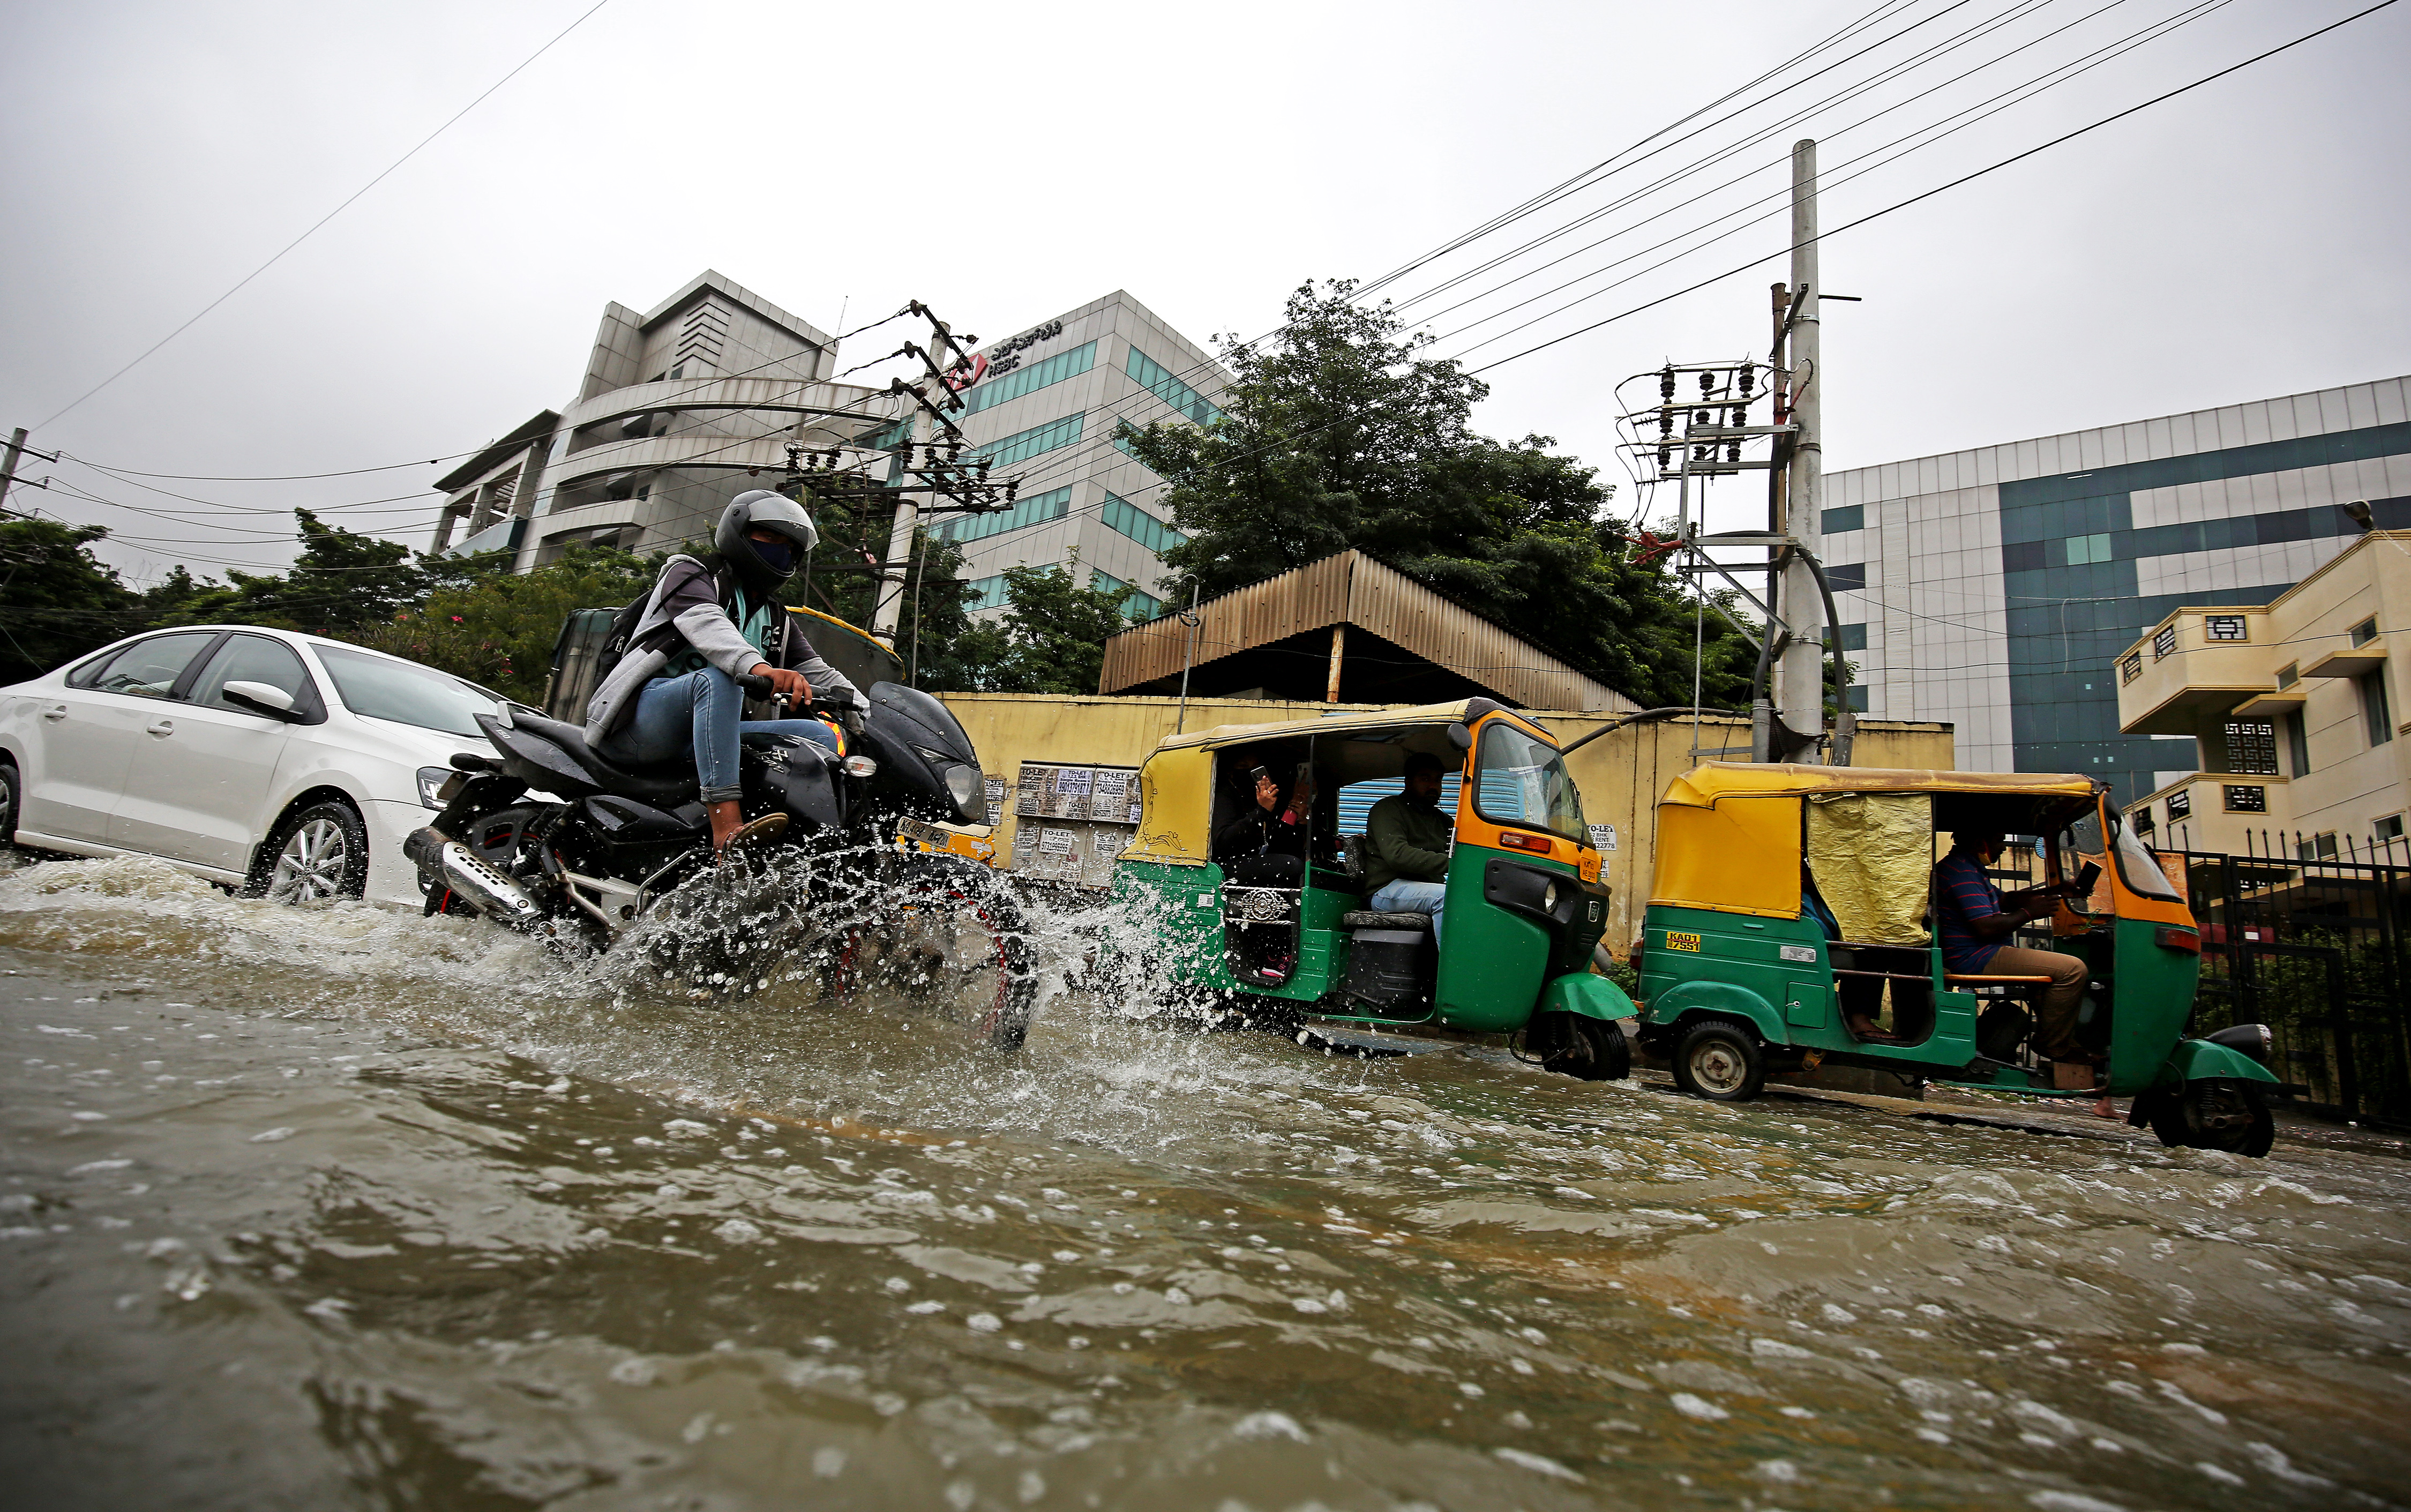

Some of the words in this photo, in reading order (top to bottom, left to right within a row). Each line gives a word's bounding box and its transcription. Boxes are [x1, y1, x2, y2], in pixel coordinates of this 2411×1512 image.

[987, 354, 1020, 378] HSBC
[496, 729, 511, 739] 150
[1670, 933, 1697, 941] KA01
[1673, 940, 1698, 951] 7551
